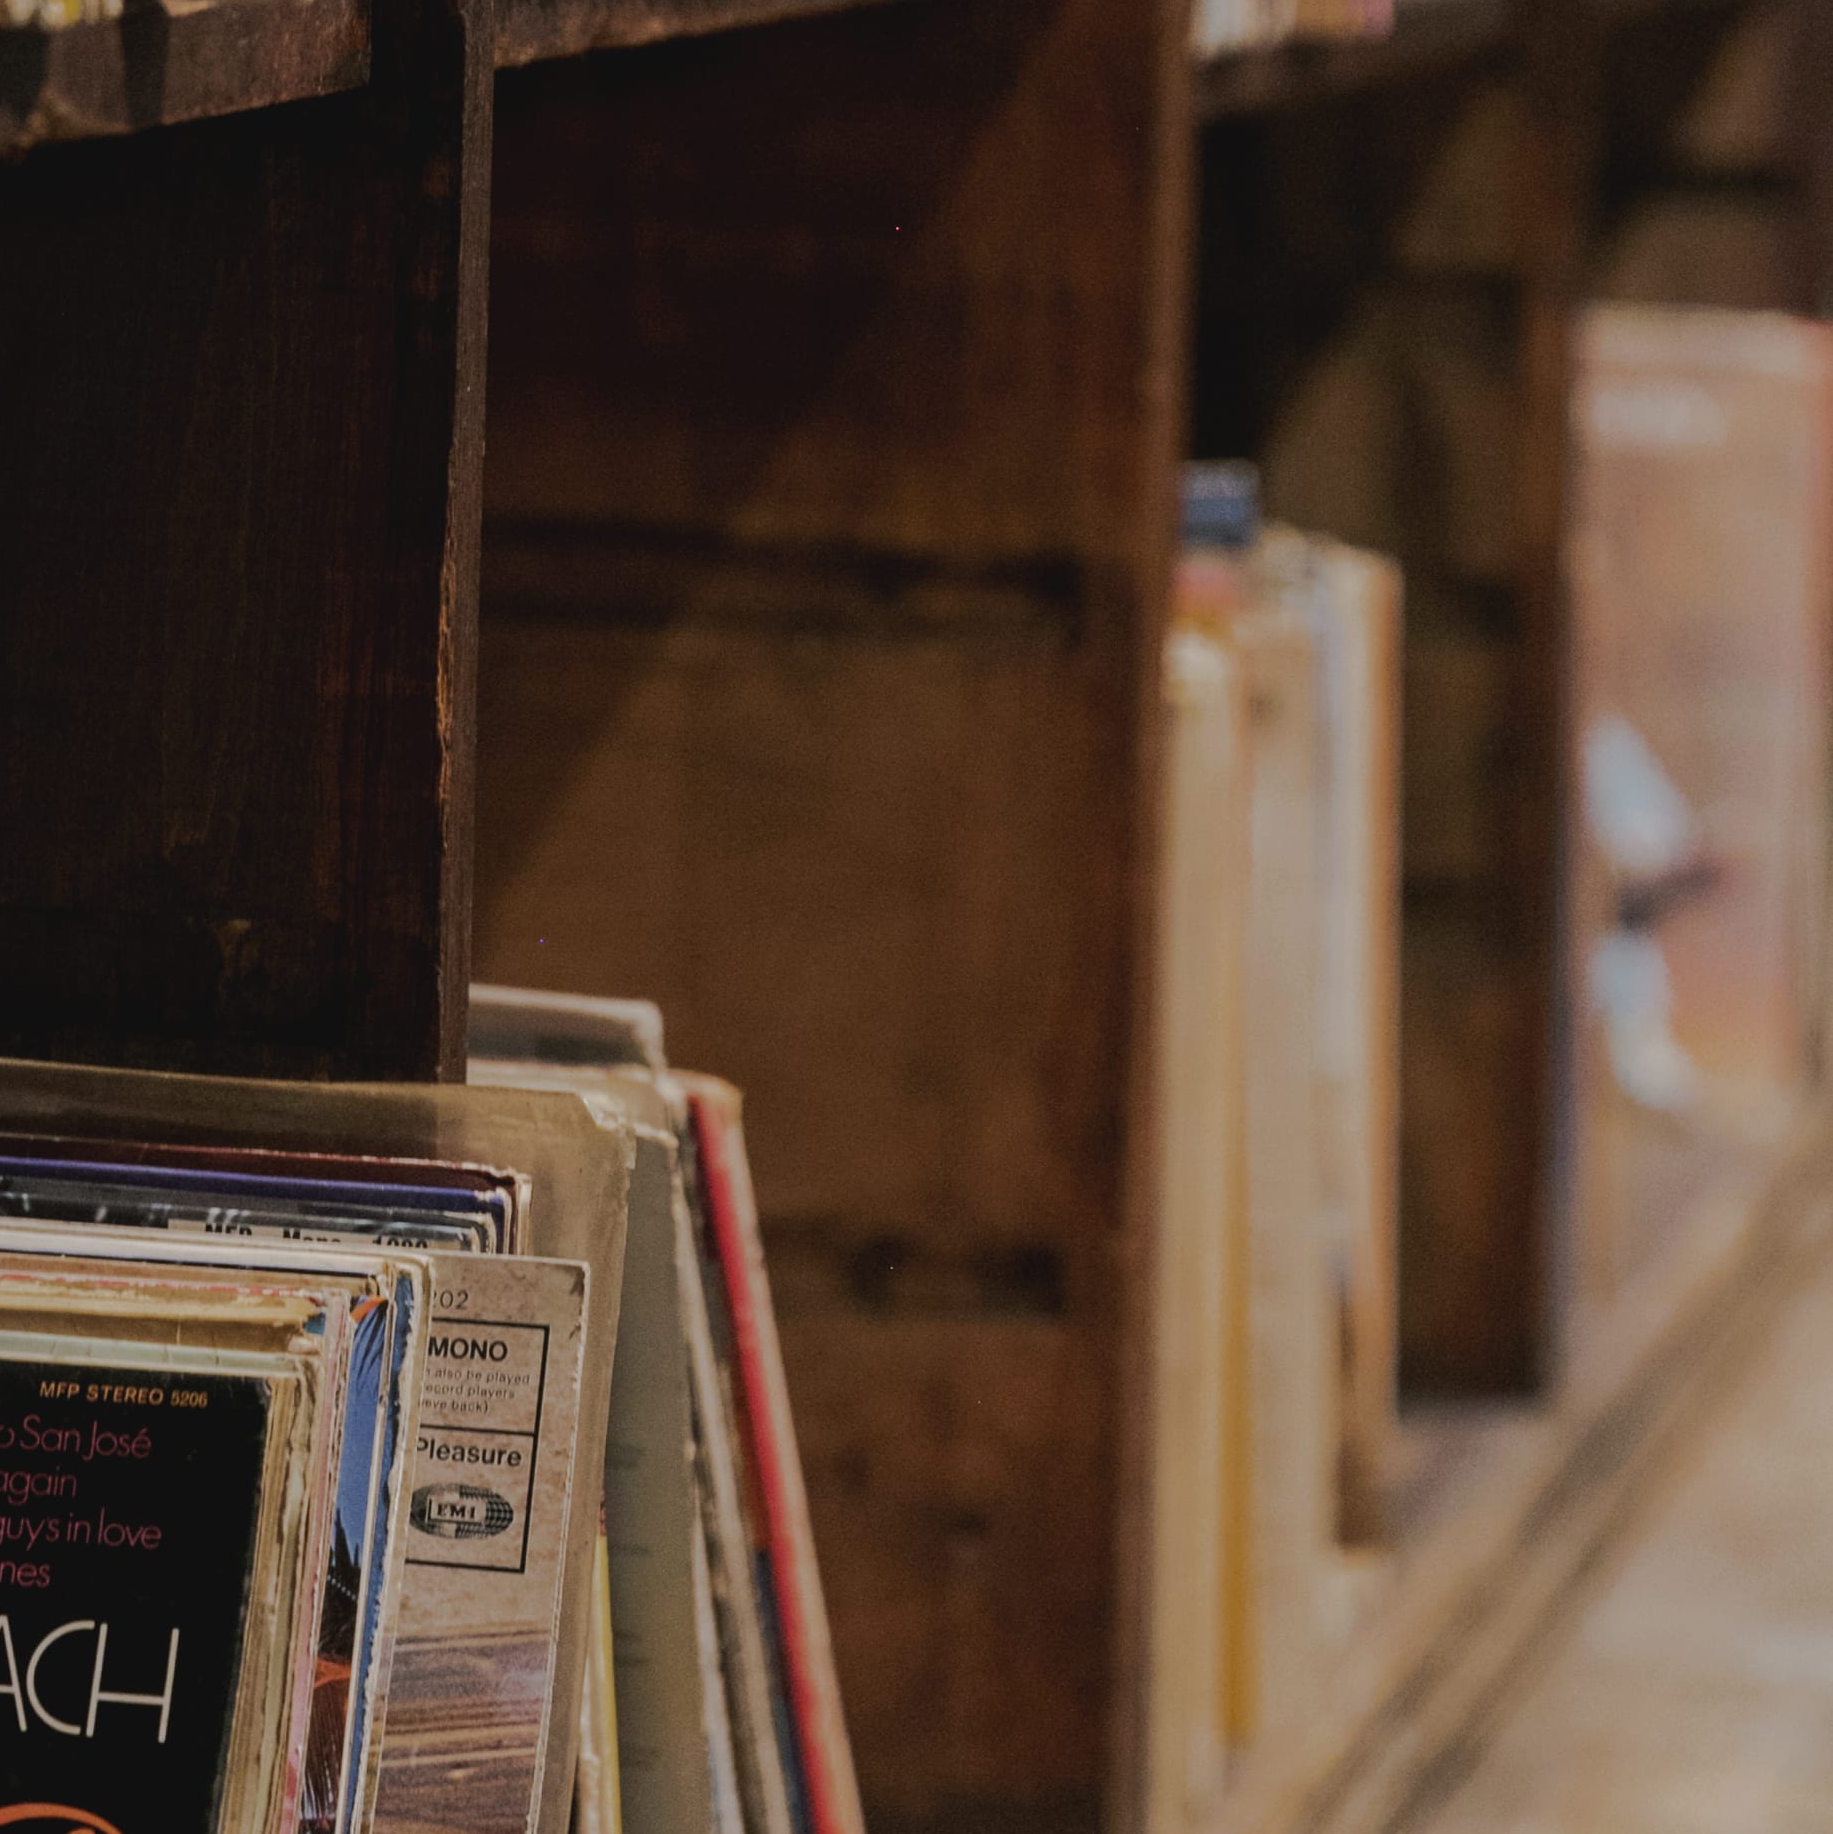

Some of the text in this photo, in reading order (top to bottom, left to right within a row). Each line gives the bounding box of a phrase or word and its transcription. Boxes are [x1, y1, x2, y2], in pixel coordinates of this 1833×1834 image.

[434, 1289, 469, 1310] 02
[428, 1335, 508, 1362] MONO
[434, 1368, 462, 1380] also
[486, 1372, 530, 1385] played
[39, 1380, 210, 1408] MFP STEREO 5206
[424, 1383, 515, 1399] ecord players
[19, 1414, 82, 1454] San
[82, 1418, 153, 1462] José
[437, 1503, 476, 1519] EMI
[65, 1512, 92, 1545] in
[96, 1505, 163, 1551] love
